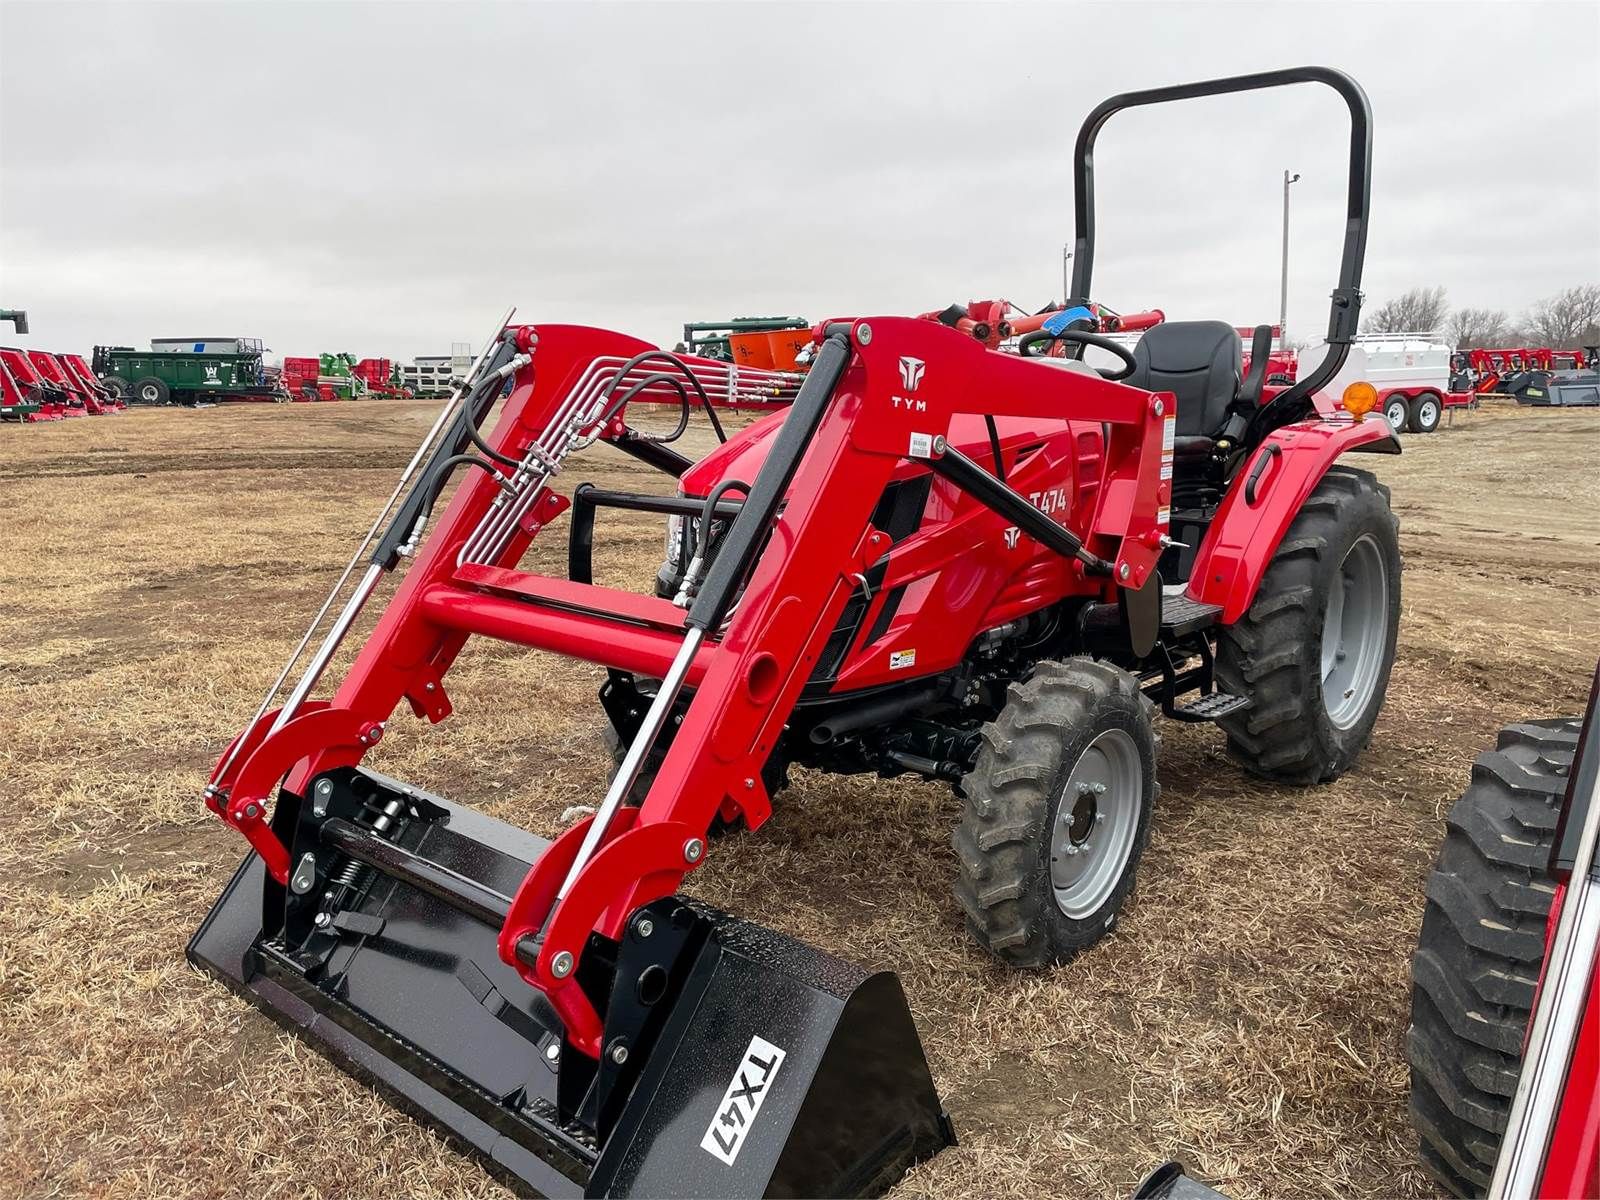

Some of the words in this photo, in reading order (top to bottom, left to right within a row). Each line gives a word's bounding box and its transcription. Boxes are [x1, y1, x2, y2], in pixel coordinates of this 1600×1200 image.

[891, 396, 927, 412] TYM
[1029, 488, 1067, 514] T474
[712, 1053, 778, 1156] TX47
